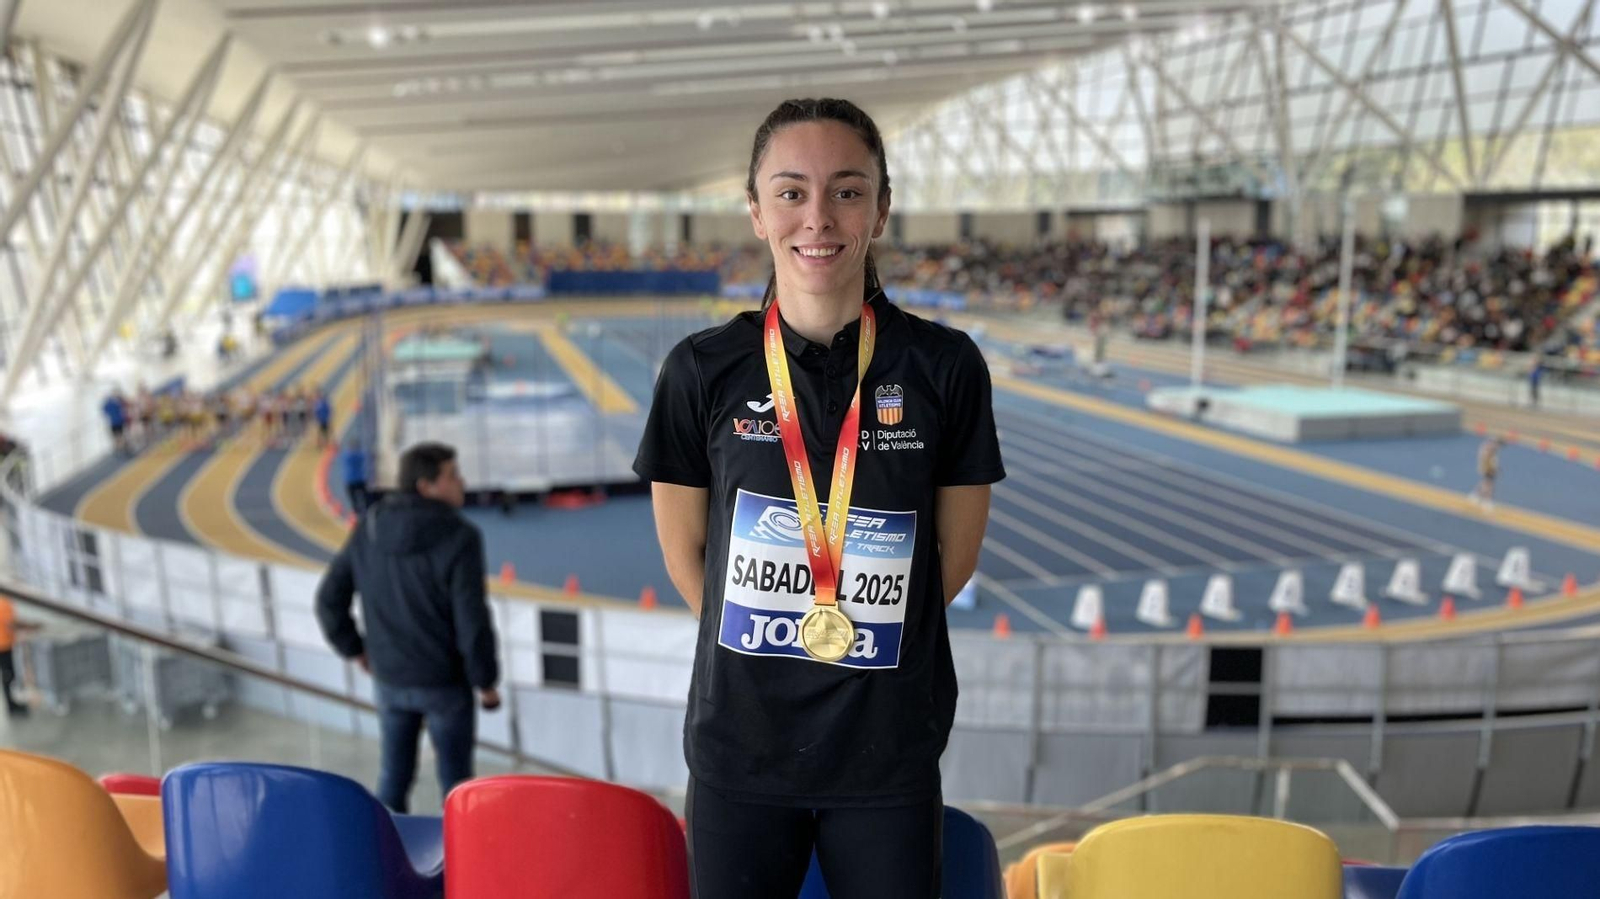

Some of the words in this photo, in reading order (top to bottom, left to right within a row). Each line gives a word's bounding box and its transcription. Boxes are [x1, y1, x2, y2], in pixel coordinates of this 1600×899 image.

[769, 328, 782, 386] ATLETISMO
[877, 428, 917, 441] Diputació
[877, 441, 890, 451] de
[890, 440, 924, 450] València
[794, 460, 813, 521] ATLETISMO
[836, 447, 850, 509] ATLETISMO
[846, 513, 887, 529] FEA
[857, 543, 896, 555] TRACK
[732, 555, 847, 601] SABADL
[851, 572, 904, 606] 2025
[741, 614, 878, 659] Joa
